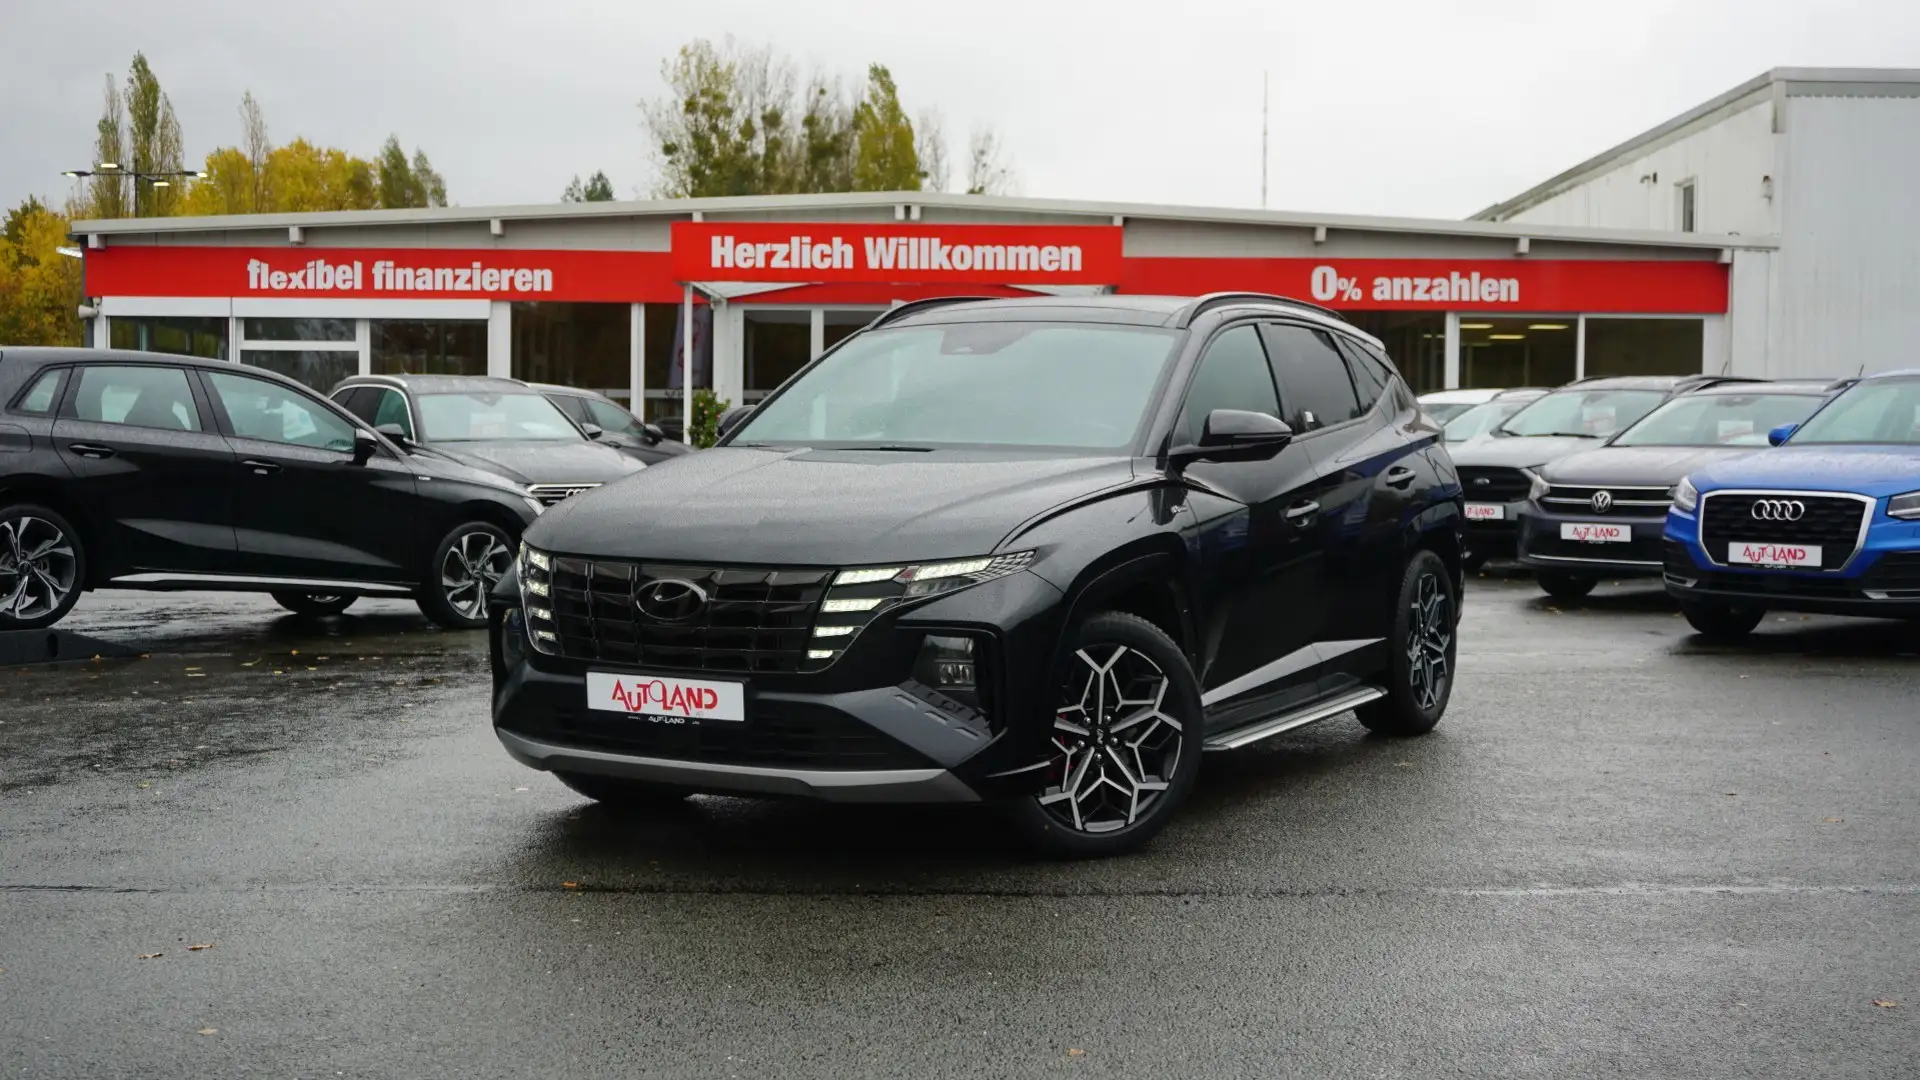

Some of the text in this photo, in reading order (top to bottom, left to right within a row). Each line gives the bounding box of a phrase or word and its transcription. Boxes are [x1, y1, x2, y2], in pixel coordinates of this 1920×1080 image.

[711, 235, 1083, 271] Herzlich Willkommen
[247, 258, 553, 292] flexibel finanzieren
[1310, 265, 1520, 302] 0% anzahlen
[611, 679, 719, 716] AUTOLAND
